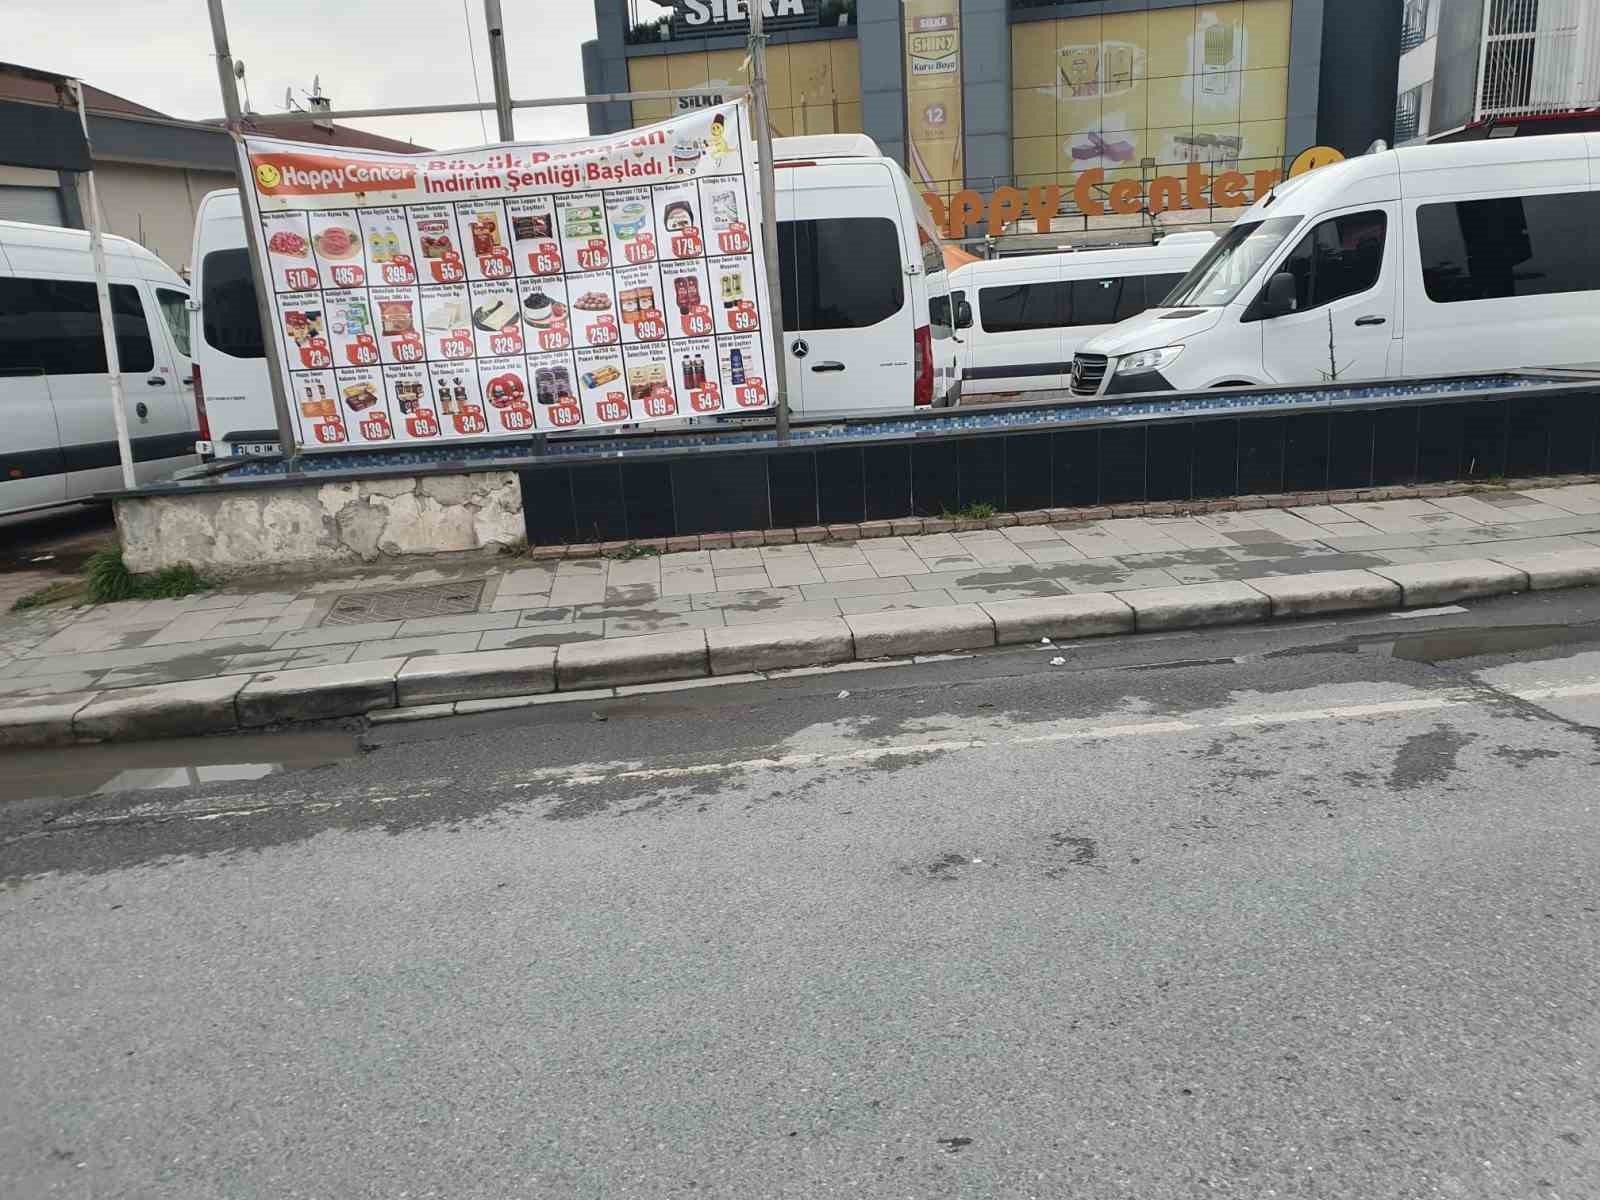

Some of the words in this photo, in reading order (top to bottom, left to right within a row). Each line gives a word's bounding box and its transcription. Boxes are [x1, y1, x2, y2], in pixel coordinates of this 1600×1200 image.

[506, 164, 581, 193] Şenliği
[586, 156, 663, 184] Başladı
[1073, 162, 1285, 217] Center
